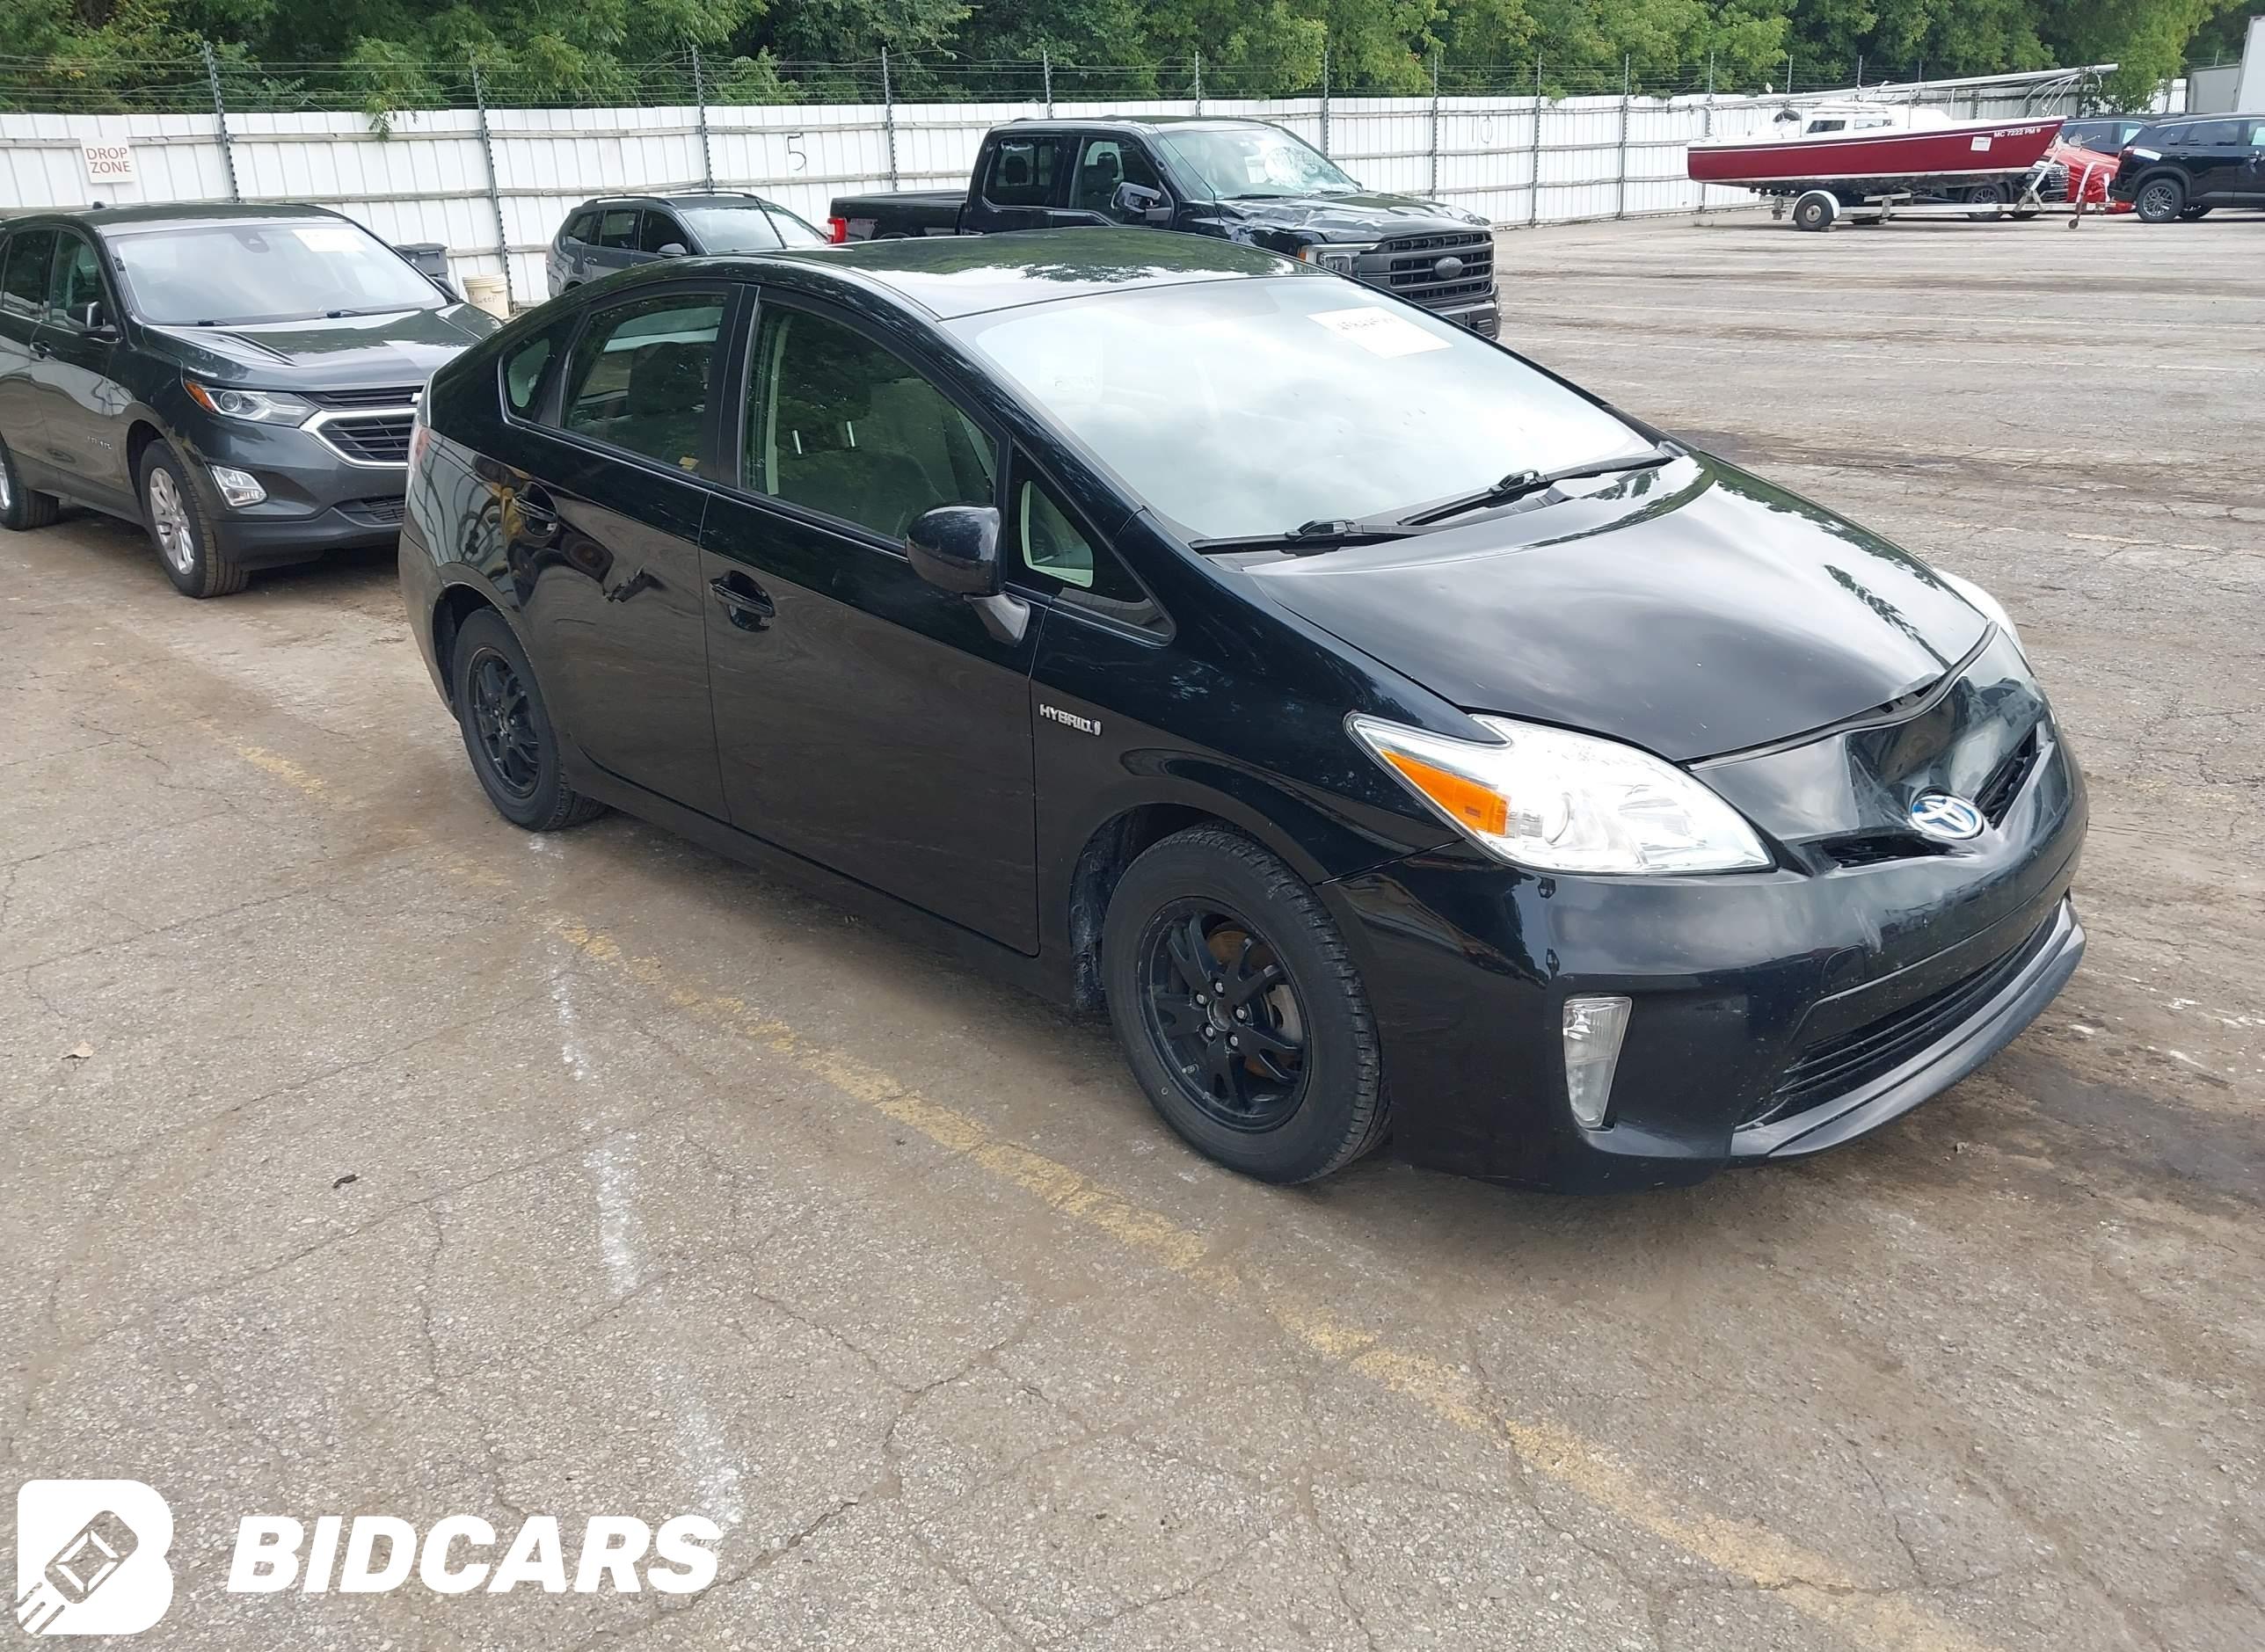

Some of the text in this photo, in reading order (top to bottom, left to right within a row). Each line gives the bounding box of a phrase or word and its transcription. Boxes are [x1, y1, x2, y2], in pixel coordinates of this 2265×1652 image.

[85, 147, 127, 160] DROP
[787, 132, 807, 171] 5
[90, 161, 132, 173] ZONE
[1039, 703, 1092, 733] HYBRID
